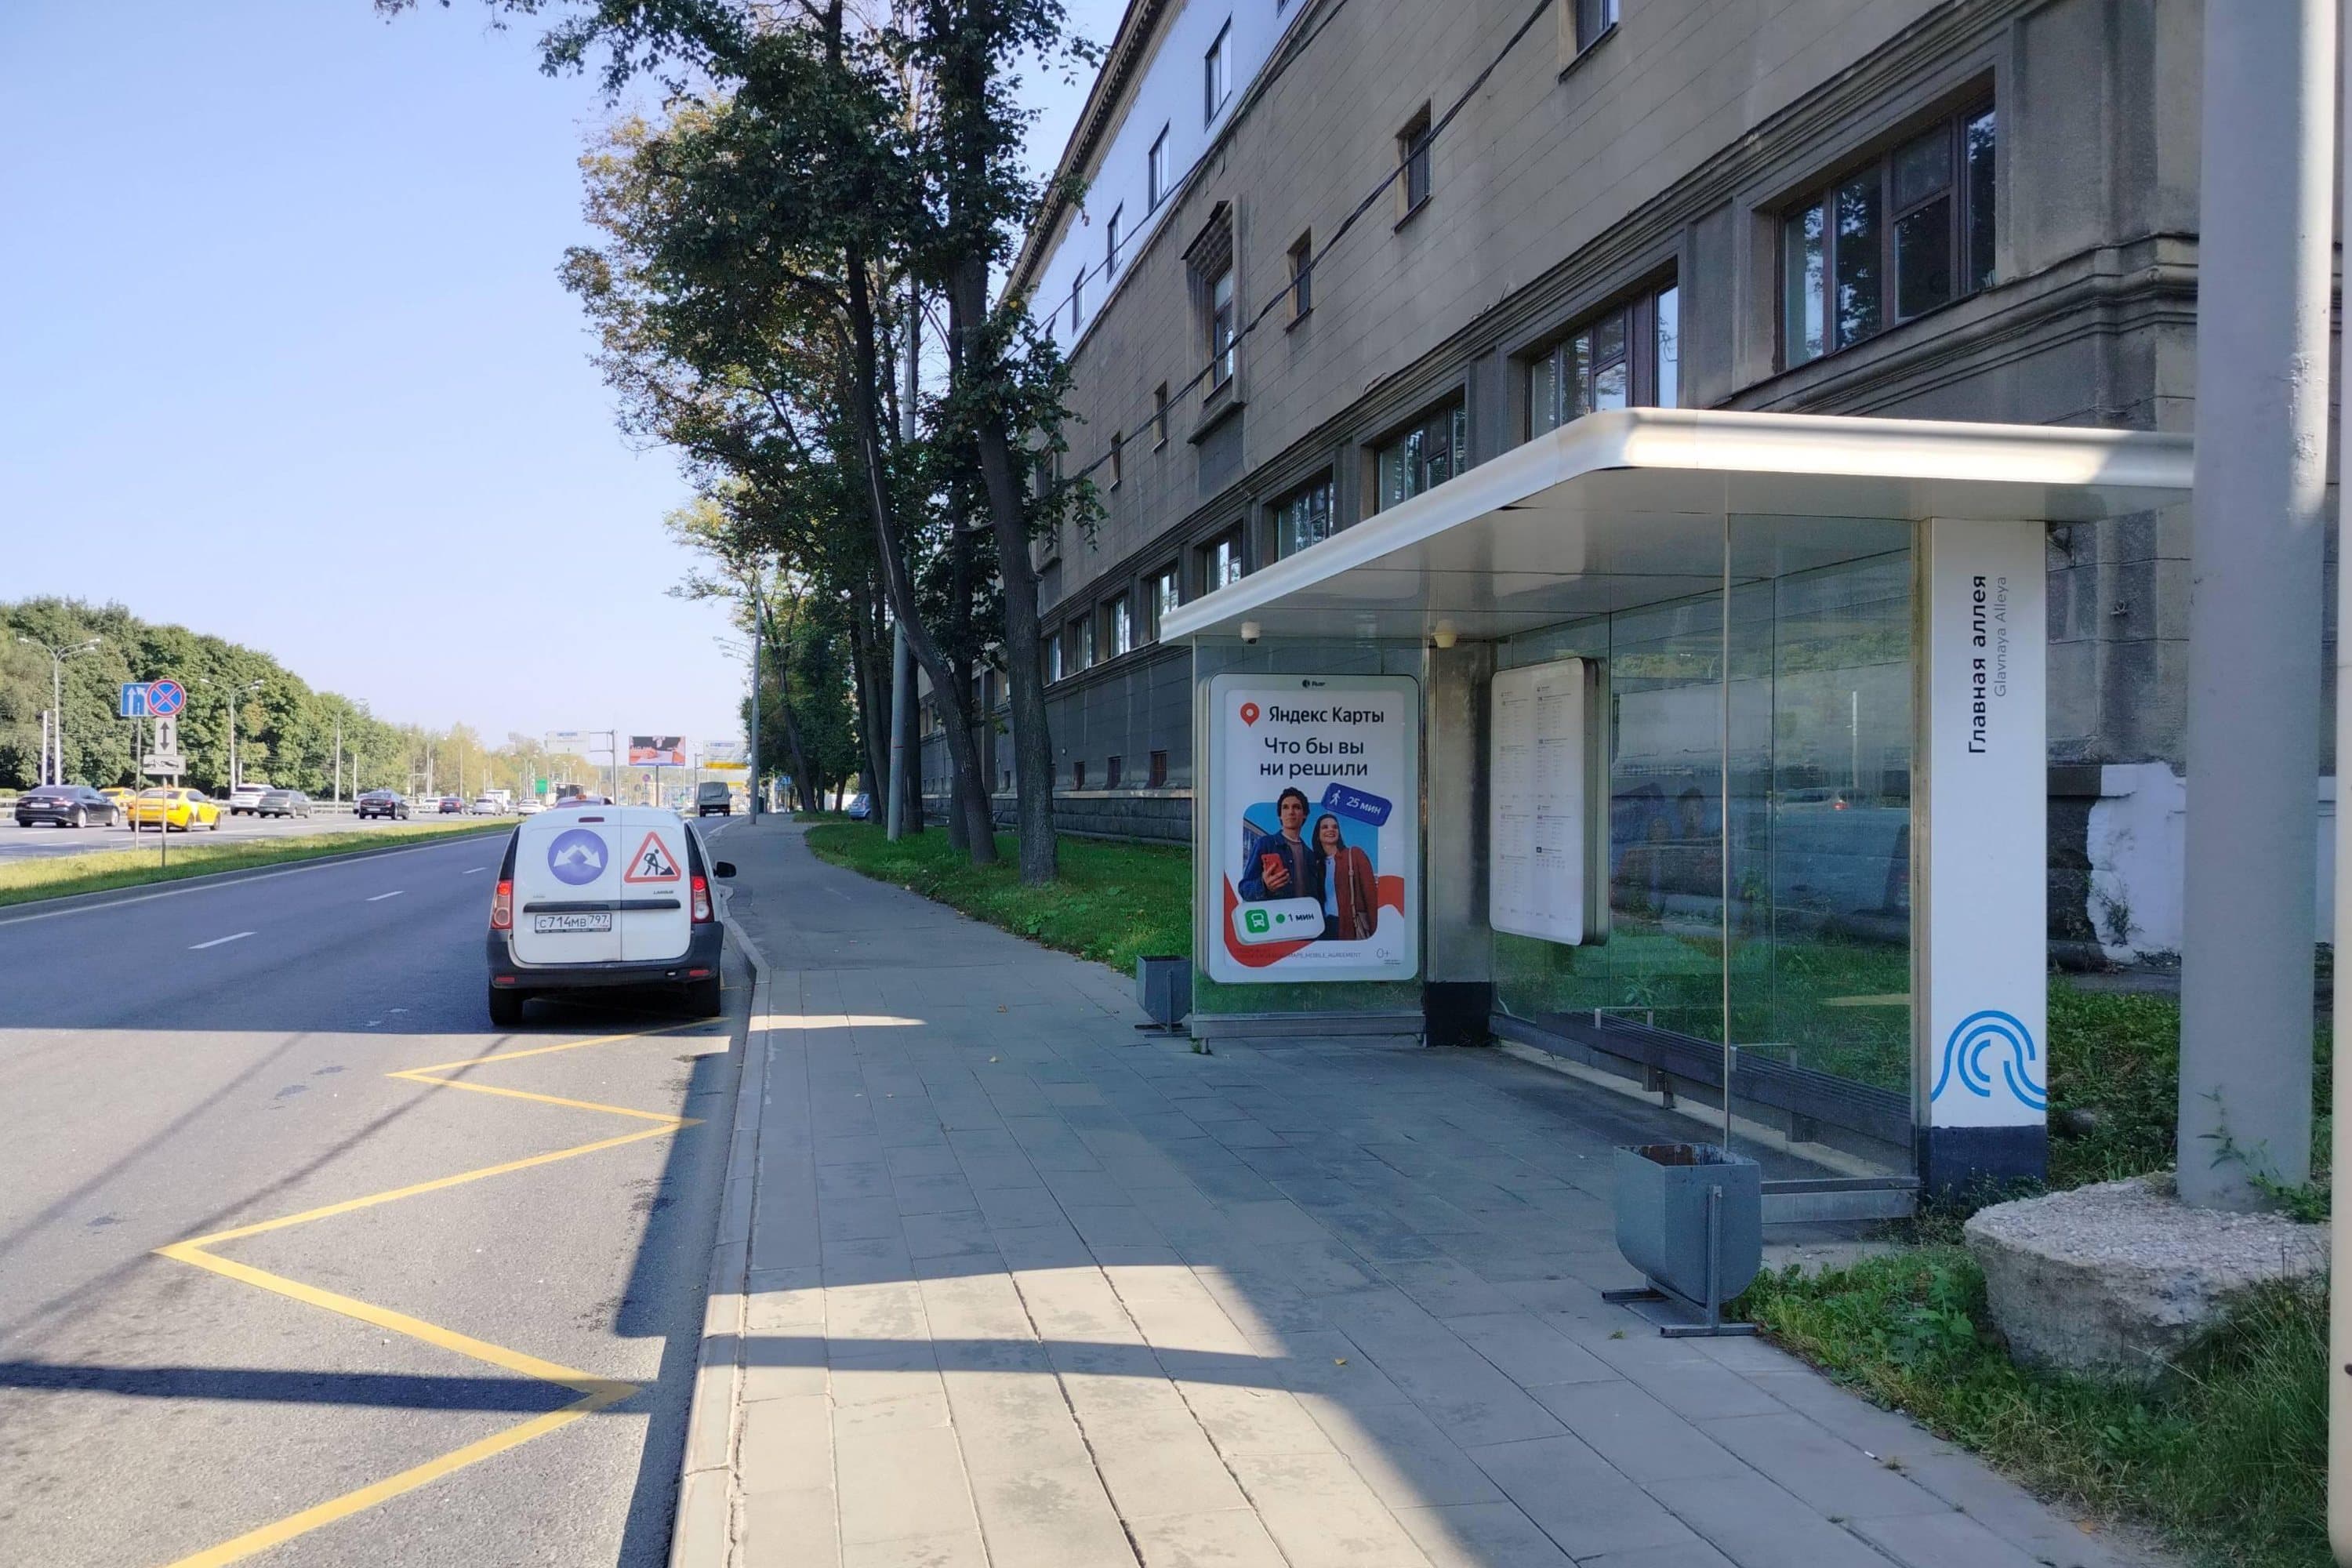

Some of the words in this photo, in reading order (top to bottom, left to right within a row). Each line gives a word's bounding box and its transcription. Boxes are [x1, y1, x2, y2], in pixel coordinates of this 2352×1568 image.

[1994, 576, 2009, 622] Alleya
[1973, 575, 1986, 648] аллея
[1994, 627, 2009, 697] Glavnaya
[1968, 658, 1986, 753] Главная
[1269, 706, 1328, 724] Яндекс
[1332, 706, 1385, 725] Карты
[1265, 736, 1301, 754] Что
[1305, 737, 1333, 754] бы
[1338, 741, 1364, 754] вы
[1260, 763, 1283, 776] ни
[1289, 763, 1368, 779] решили
[1346, 796, 1361, 808] 25
[1359, 803, 1381, 815] мин
[1295, 913, 1315, 922] мин
[1376, 948, 1391, 959] 0+
